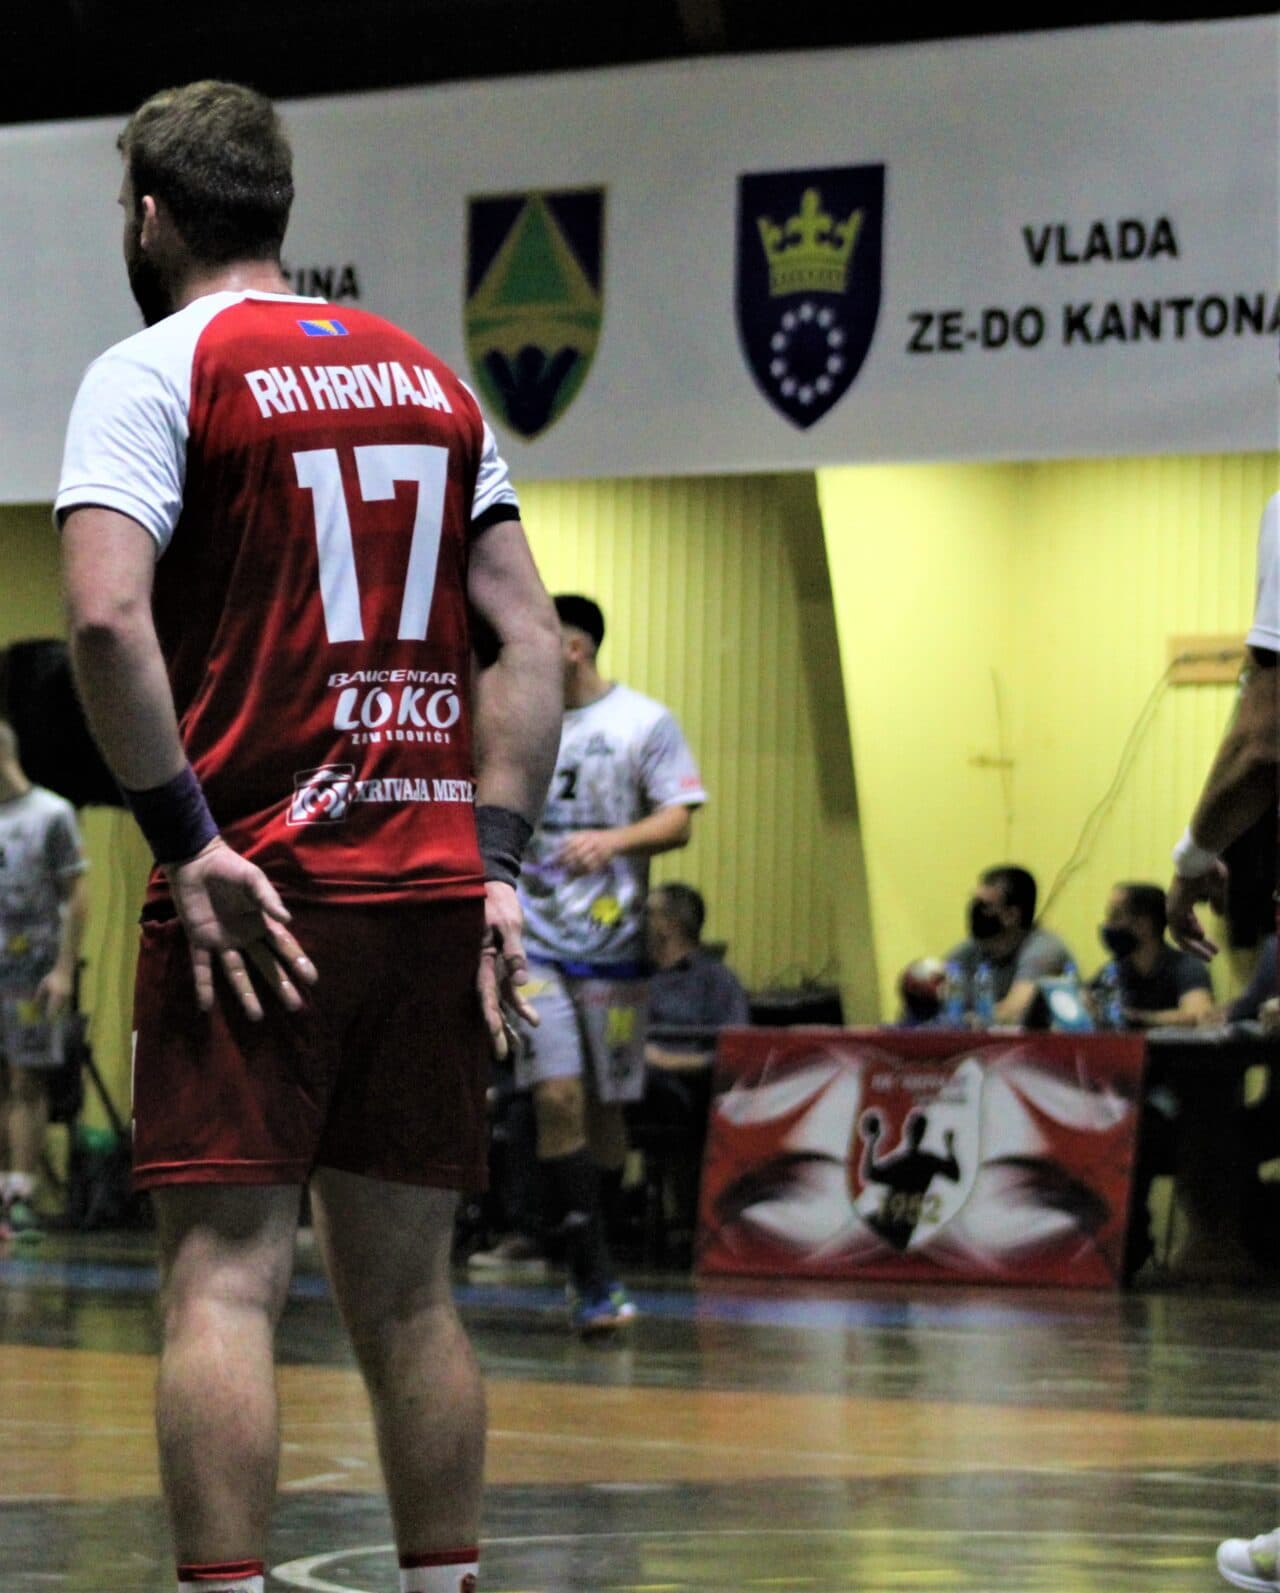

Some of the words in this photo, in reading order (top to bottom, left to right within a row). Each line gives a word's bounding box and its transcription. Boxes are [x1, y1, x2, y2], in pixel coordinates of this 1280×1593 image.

[1023, 217, 1178, 266] VLADA
[281, 264, 360, 299] INA
[906, 305, 1045, 353] ZE-DO
[244, 366, 308, 418] RK
[306, 361, 453, 414] KRIVAJA
[292, 444, 449, 644] 17
[328, 669, 457, 688] BAUCENTAR
[333, 685, 461, 731] LOKO
[354, 777, 431, 802] KRIVAJA
